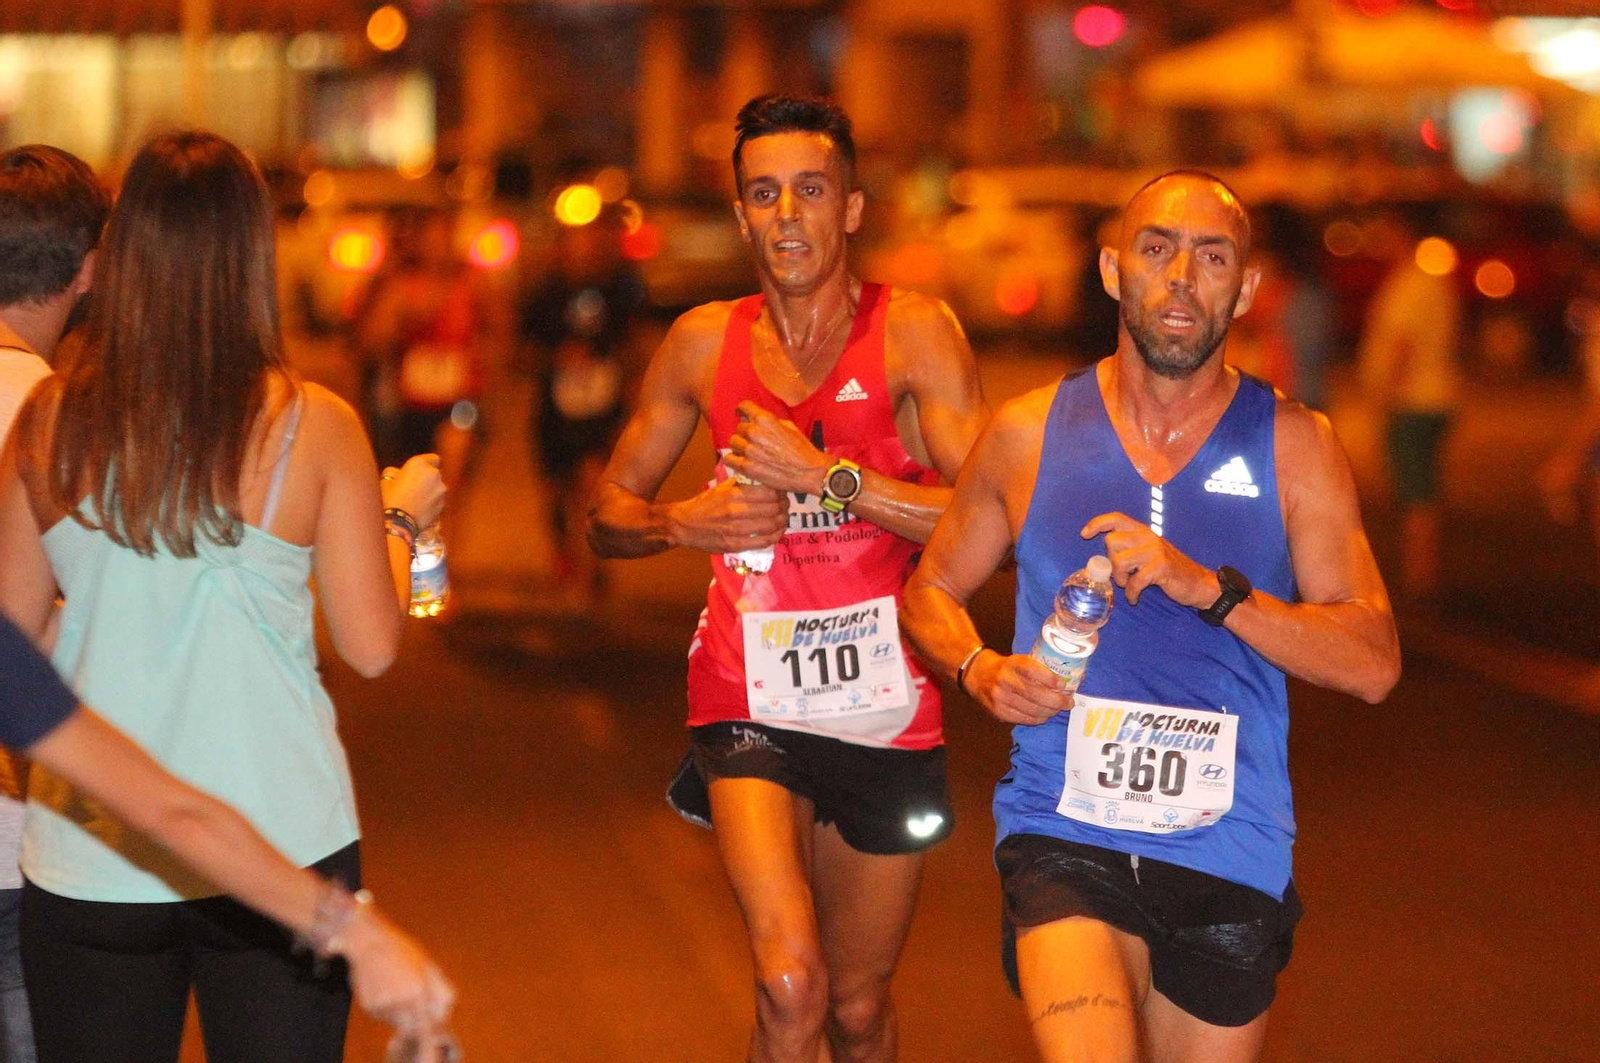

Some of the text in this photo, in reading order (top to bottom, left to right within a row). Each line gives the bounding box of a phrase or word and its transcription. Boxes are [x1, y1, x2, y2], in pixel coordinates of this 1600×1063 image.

[836, 392, 869, 402] adidas
[1204, 479, 1259, 498] adidas
[807, 532, 819, 544] &
[794, 607, 879, 633] NOCTURNA
[791, 624, 878, 647] DE HUELVA
[781, 644, 860, 688] 110
[803, 684, 842, 696] SEBASTIAN
[1083, 707, 1125, 740] VII
[1122, 711, 1220, 735] NOCTURNA
[1115, 728, 1216, 753] DE HUELVA
[1097, 742, 1187, 797] 360
[1124, 791, 1153, 803] BRUNO
